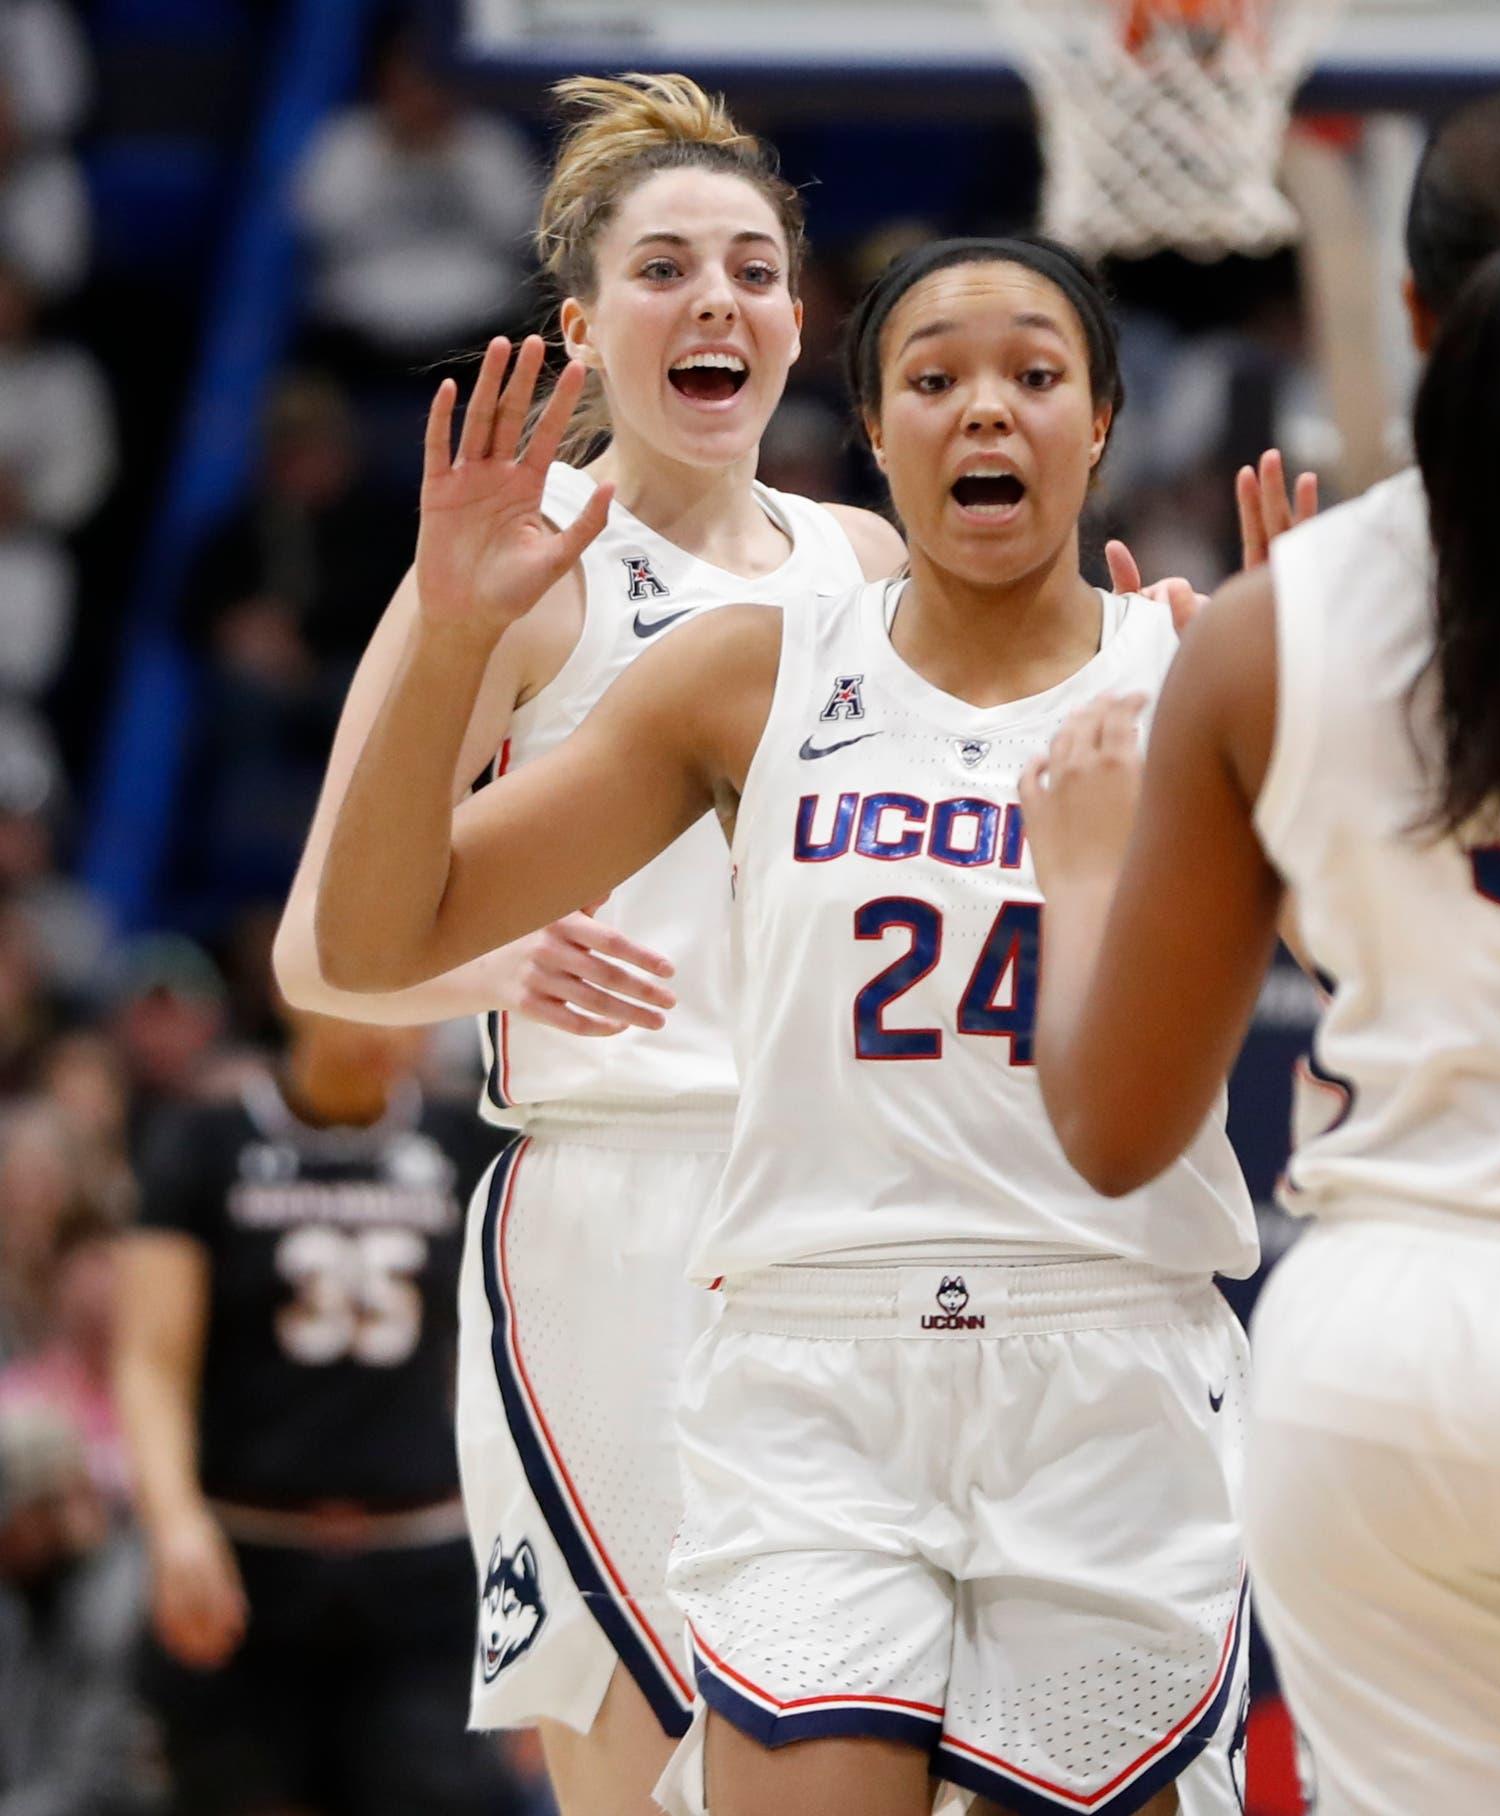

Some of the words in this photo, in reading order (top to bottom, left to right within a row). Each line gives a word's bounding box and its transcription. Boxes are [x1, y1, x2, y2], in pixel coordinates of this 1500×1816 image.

[853, 895, 1046, 1067] 24
[274, 1226, 430, 1366] 35
[920, 1314, 986, 1330] UCONN
